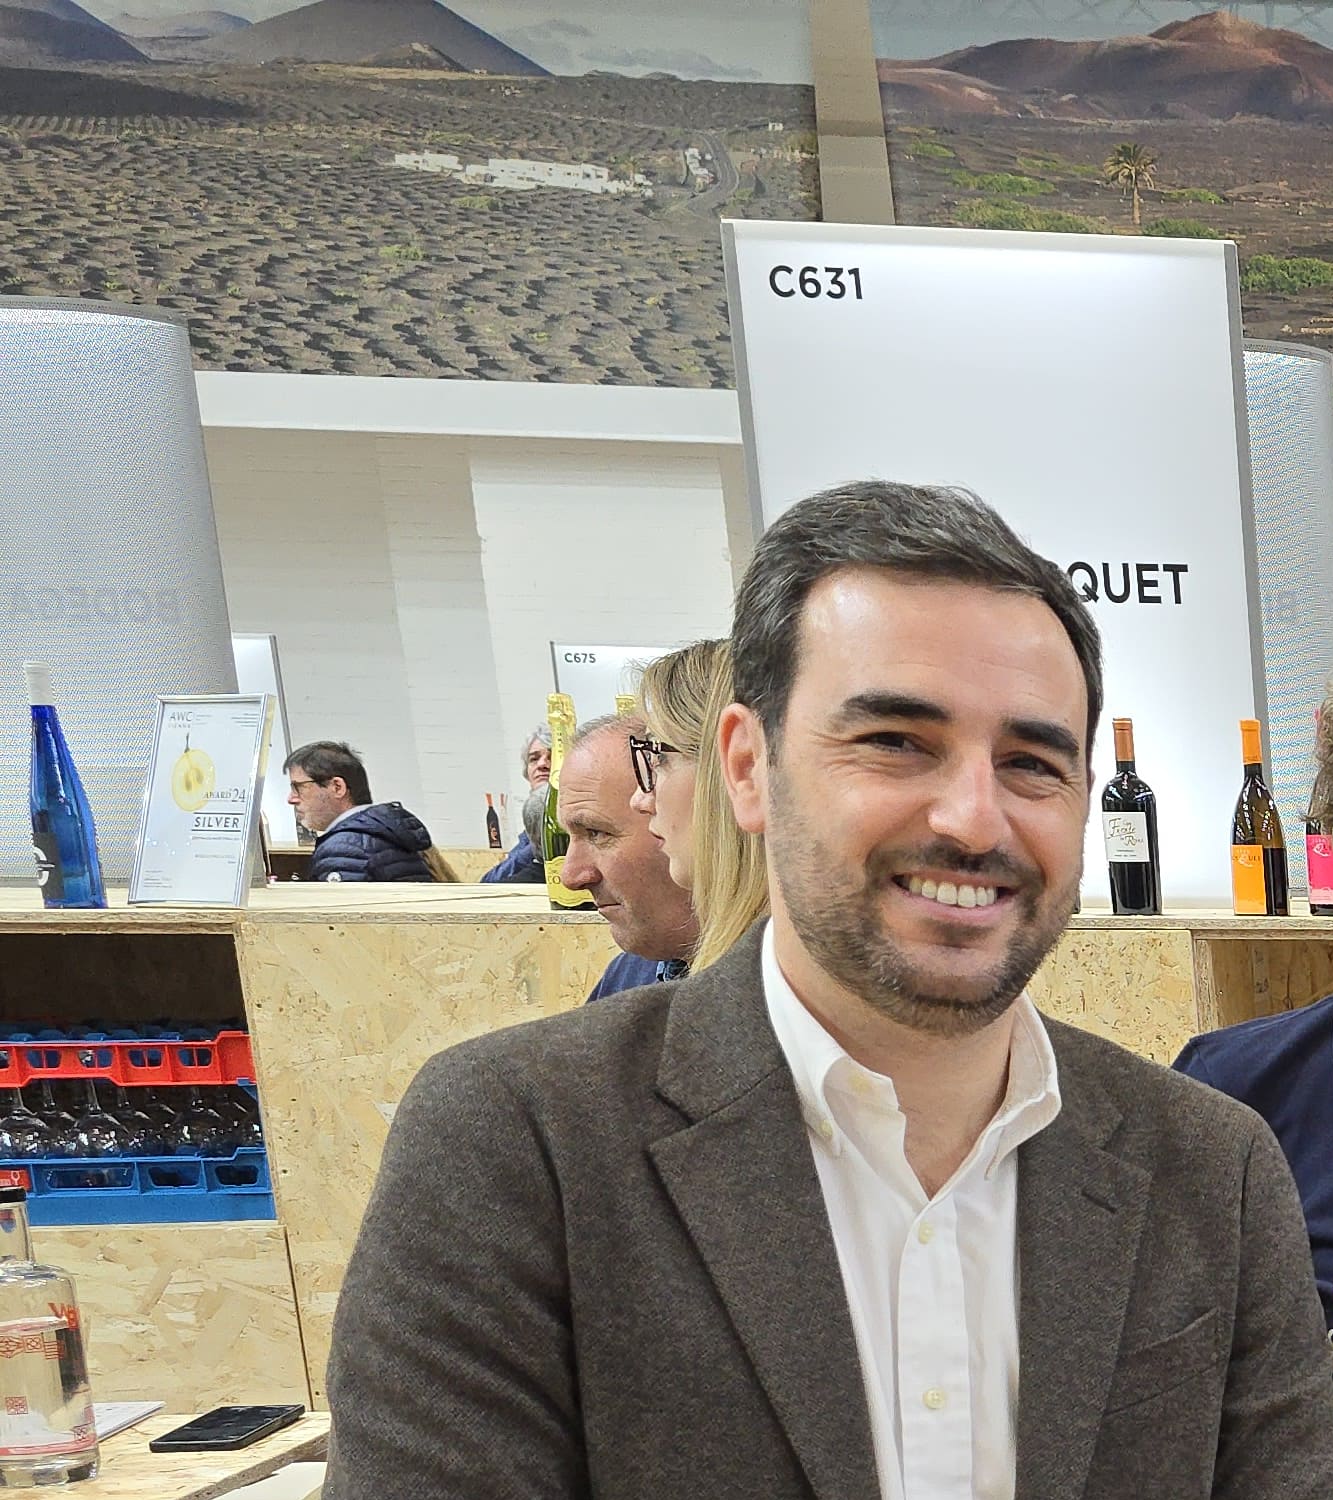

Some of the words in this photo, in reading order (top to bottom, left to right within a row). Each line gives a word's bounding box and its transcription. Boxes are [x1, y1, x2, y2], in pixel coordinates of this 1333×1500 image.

[769, 264, 864, 300] C631
[564, 651, 597, 665] C675
[194, 816, 240, 829] SILVER
